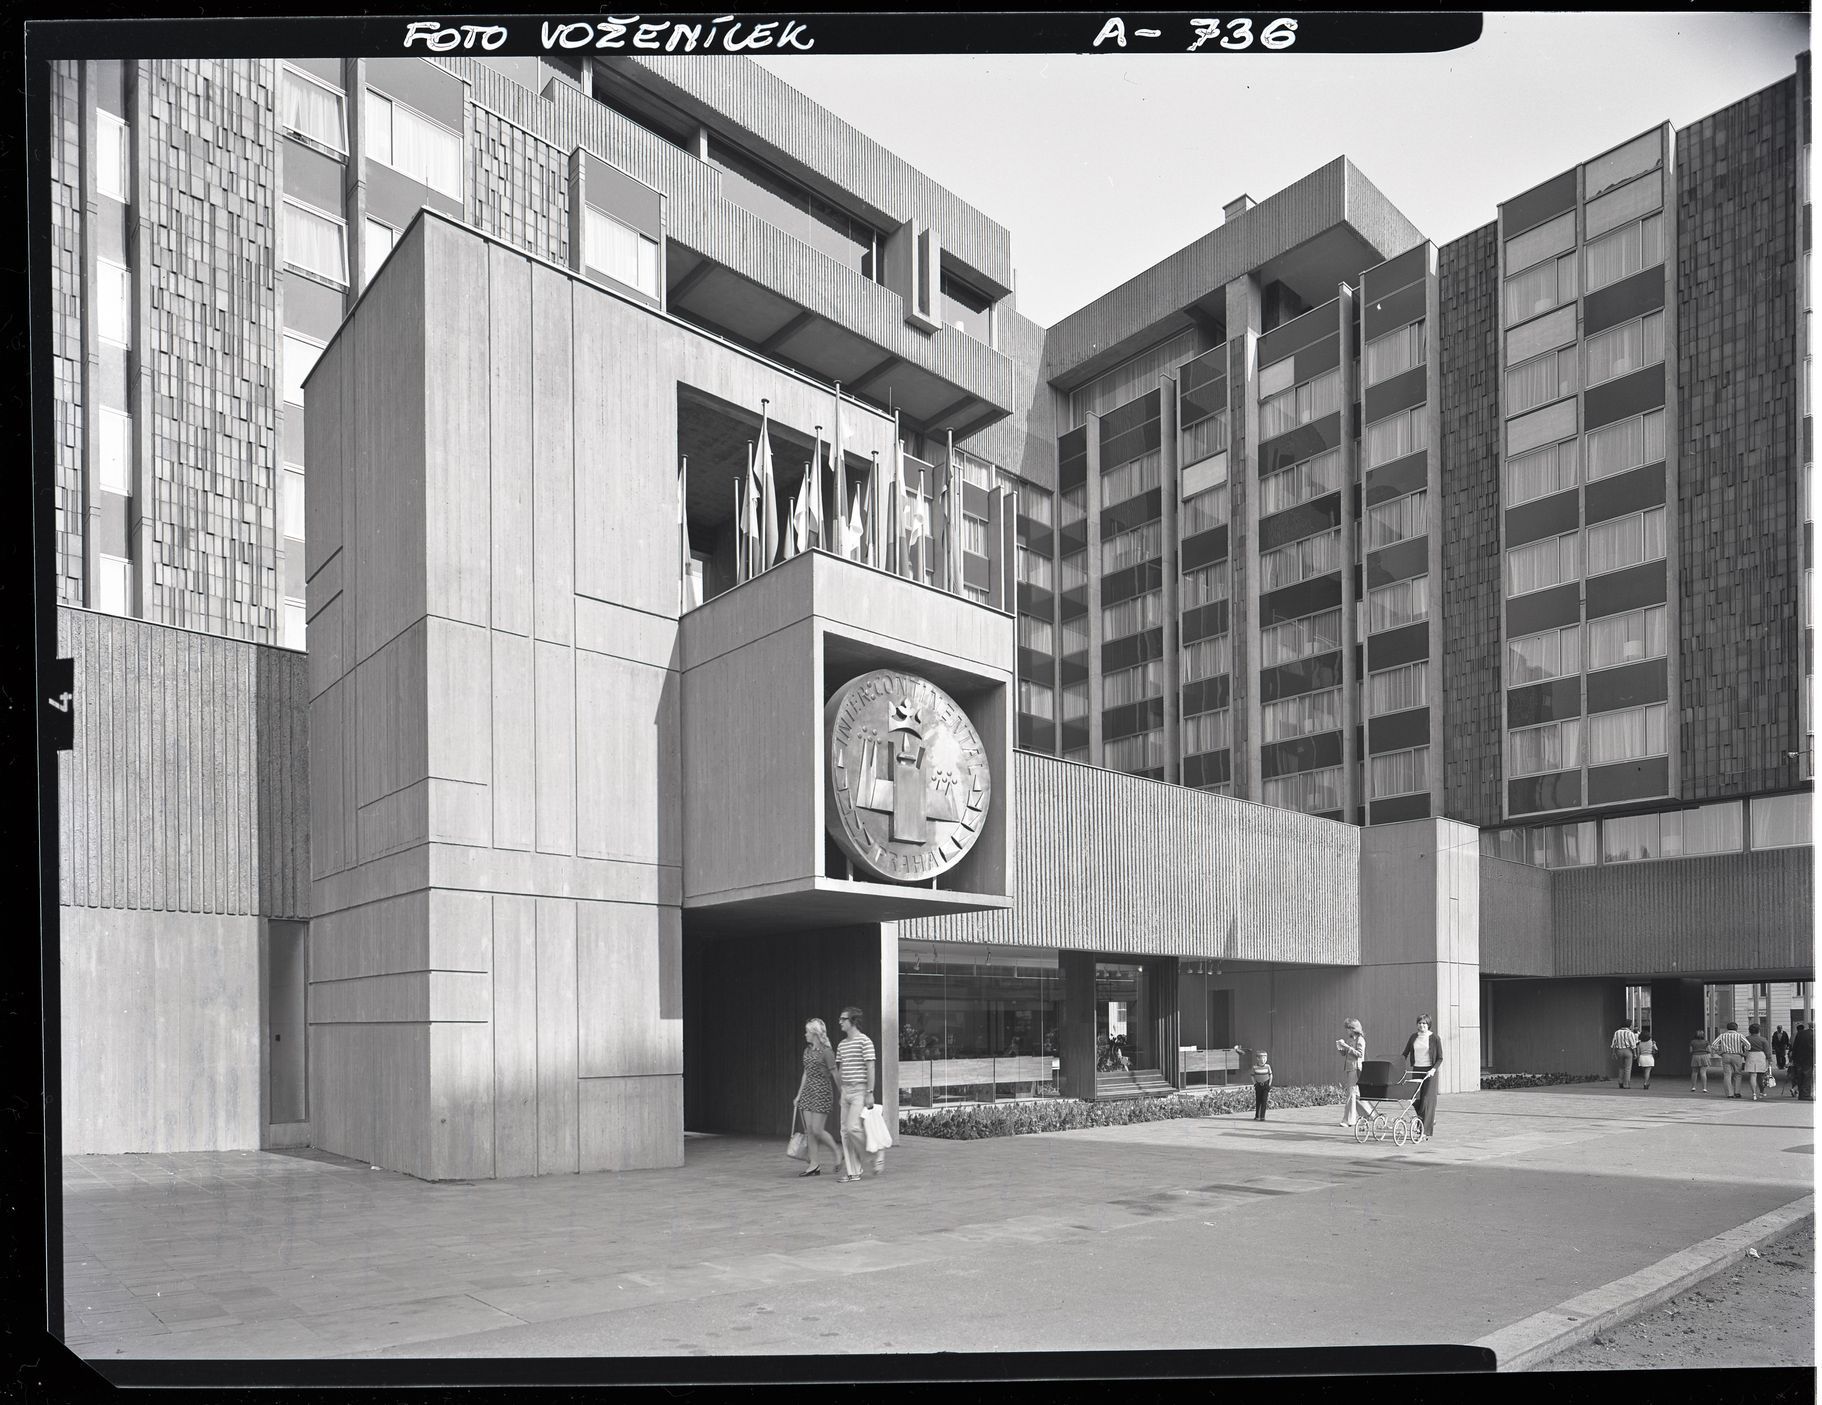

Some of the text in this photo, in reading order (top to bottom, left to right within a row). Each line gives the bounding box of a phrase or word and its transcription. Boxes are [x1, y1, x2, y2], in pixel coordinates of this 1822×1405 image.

[403, 21, 508, 50] FOTO
[1187, 18, 1299, 51] 736
[48, 691, 73, 713] 4
[874, 844, 940, 874] PRAHA
